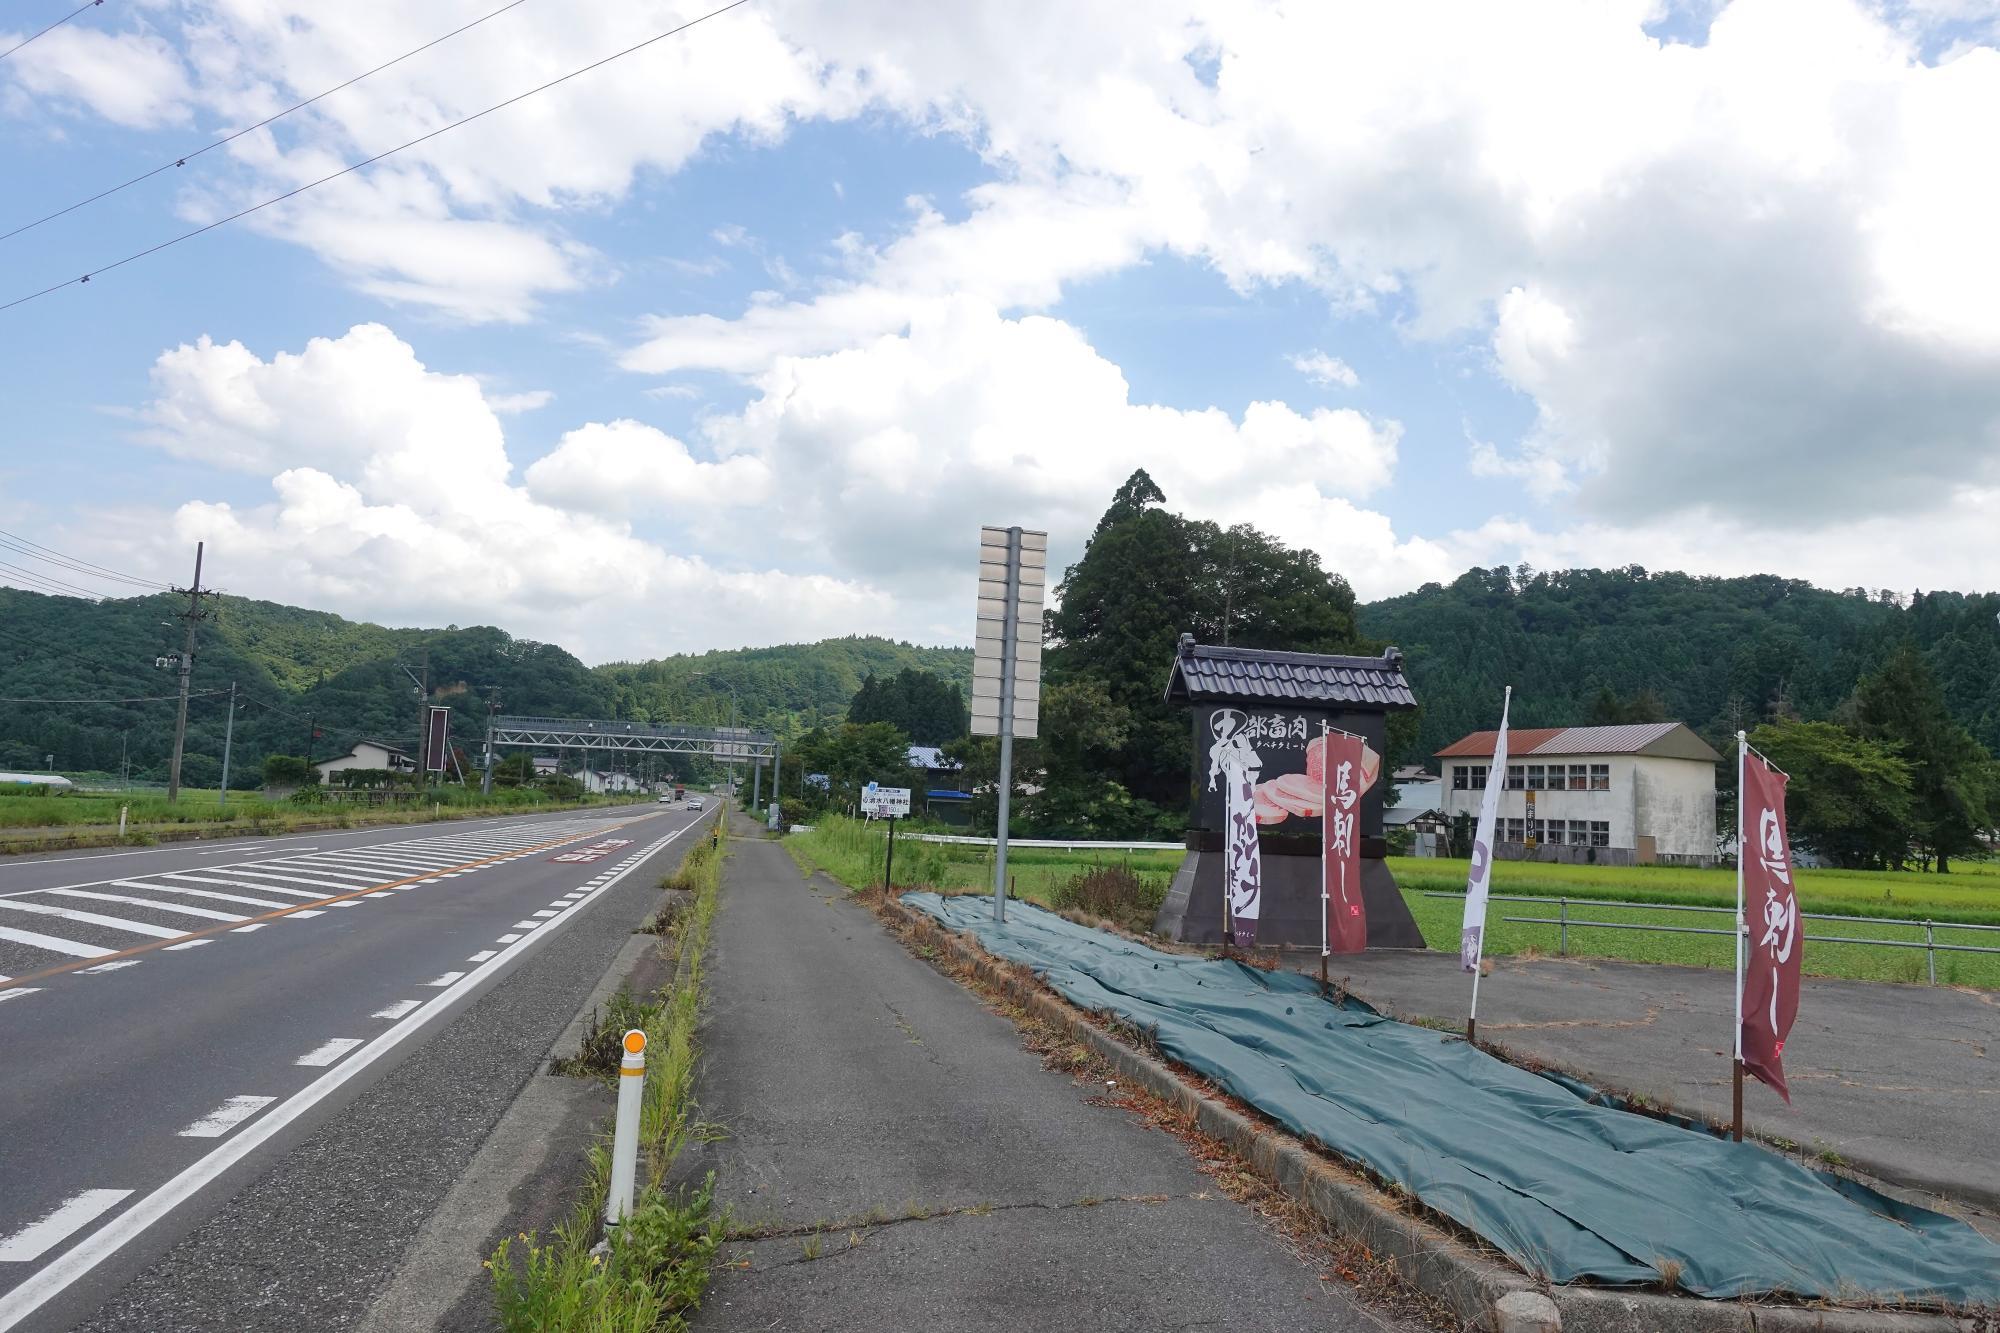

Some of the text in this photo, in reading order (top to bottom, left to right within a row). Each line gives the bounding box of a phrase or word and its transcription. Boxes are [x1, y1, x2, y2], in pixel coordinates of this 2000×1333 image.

[1331, 760, 1357, 903] 馬刺し
[1759, 807, 1796, 1037] 馬刺し
